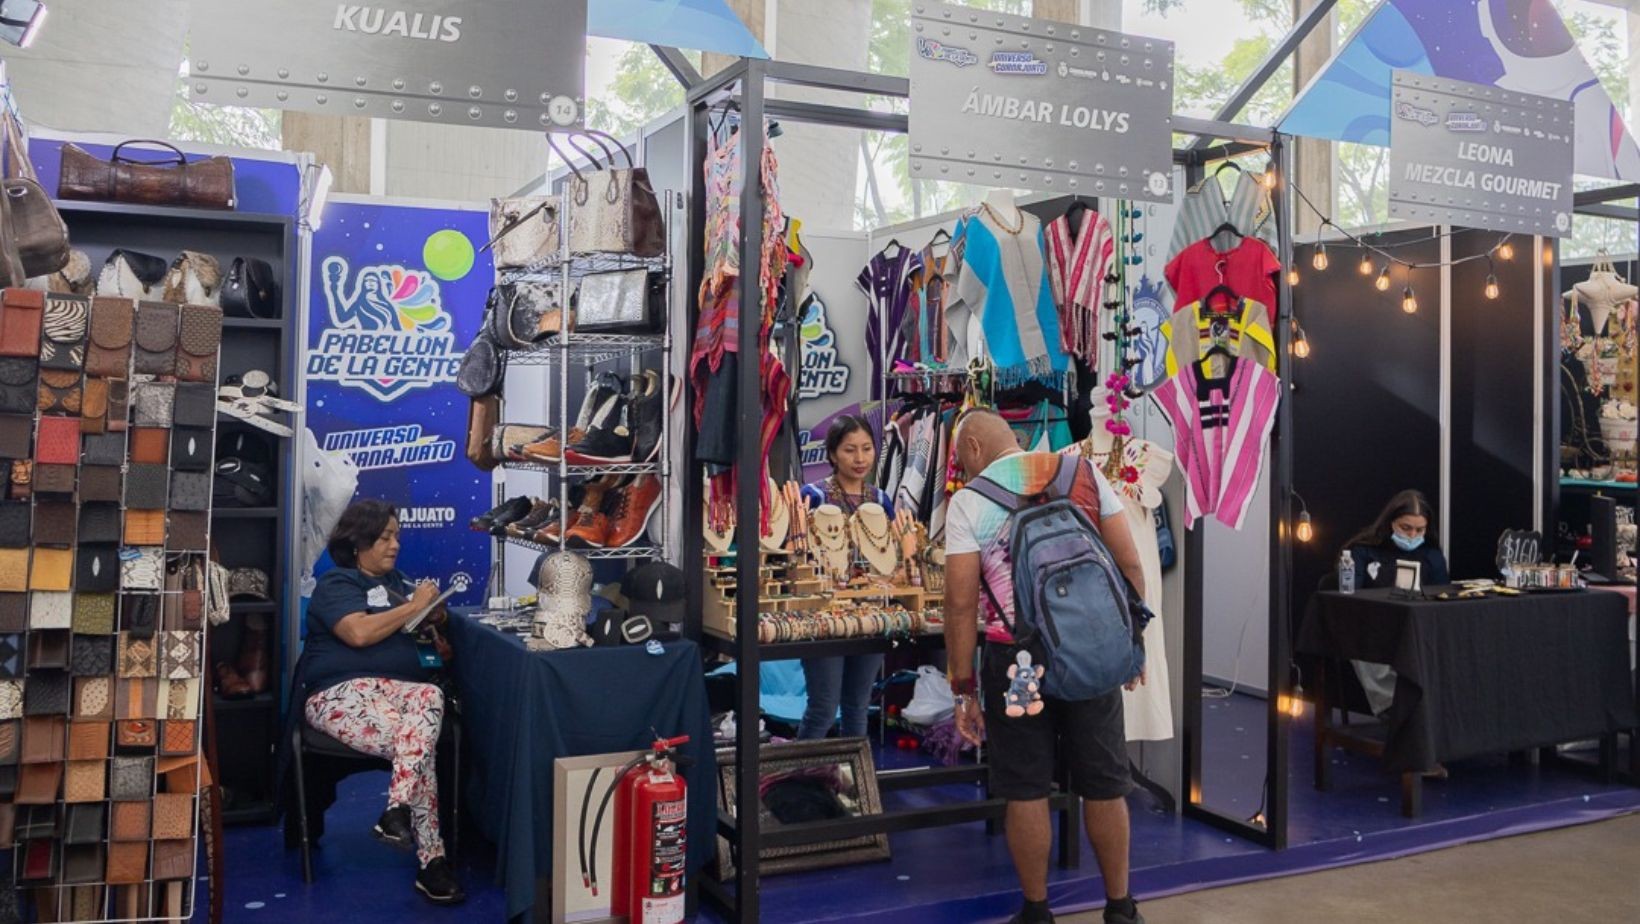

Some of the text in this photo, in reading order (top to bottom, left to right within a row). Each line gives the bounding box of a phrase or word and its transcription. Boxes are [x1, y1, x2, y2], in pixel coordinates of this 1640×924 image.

[333, 4, 462, 42] KUALIS
[556, 105, 571, 116] 14
[961, 86, 1131, 134] ÁMBAR LOLYS
[1457, 141, 1514, 167] LEONA
[1405, 162, 1562, 200] MEZCLA GOURMET
[306, 354, 462, 377] DE LA GENTE
[800, 370, 844, 388] ENTE
[326, 426, 420, 451] UNIVERSO
[396, 506, 455, 523] AJUATO
